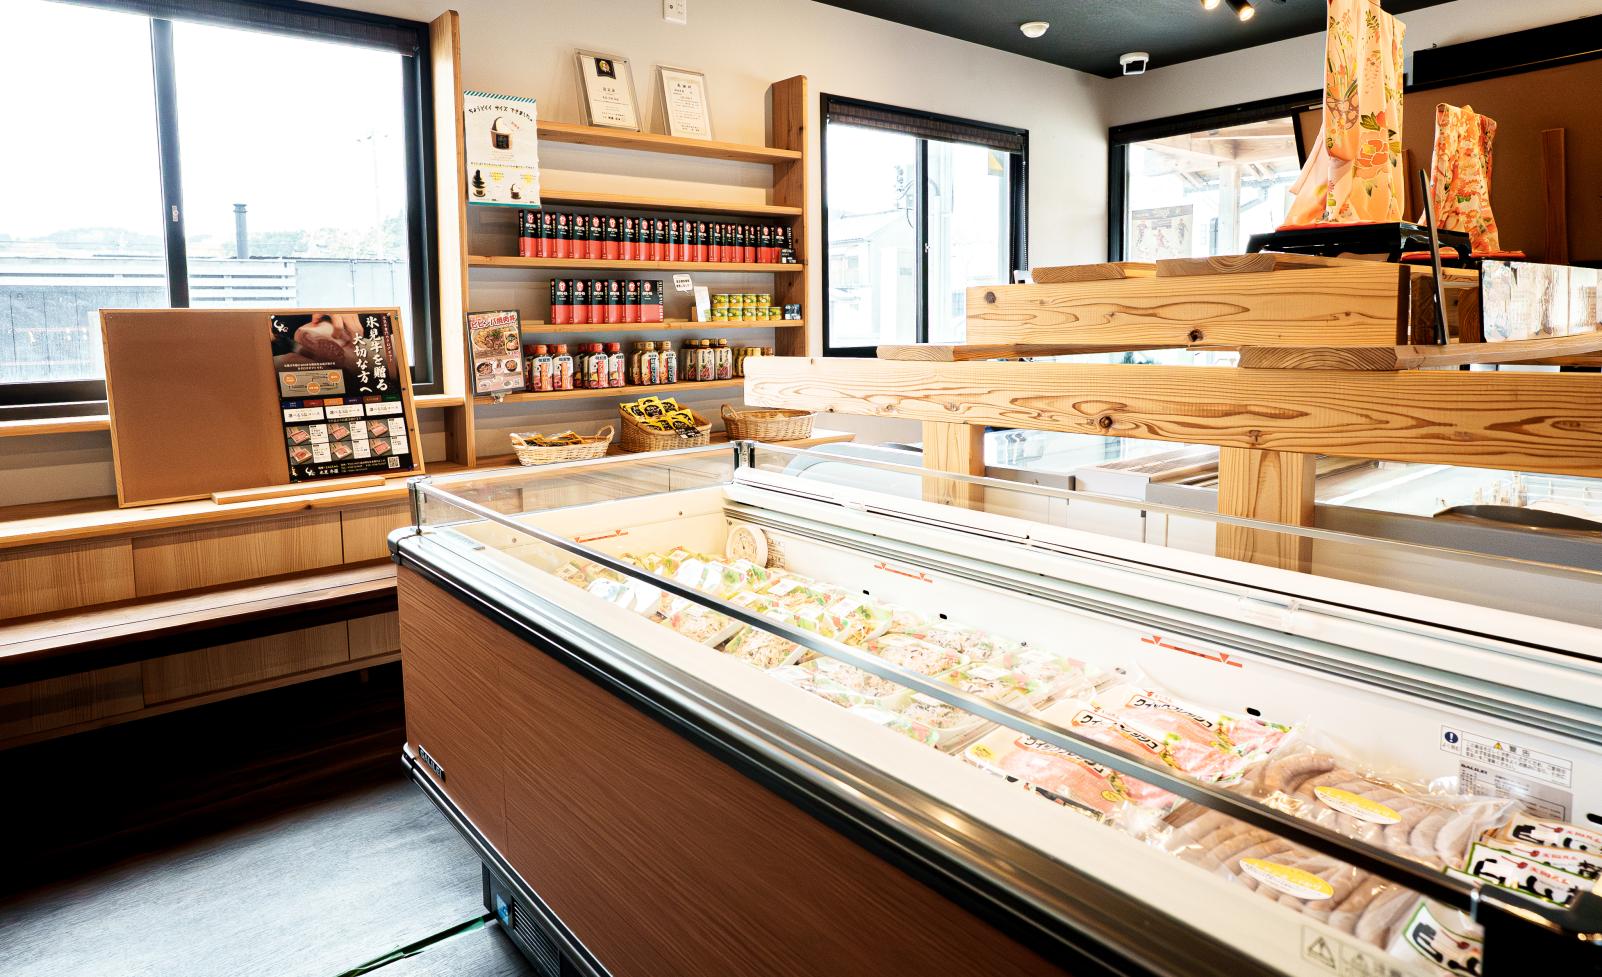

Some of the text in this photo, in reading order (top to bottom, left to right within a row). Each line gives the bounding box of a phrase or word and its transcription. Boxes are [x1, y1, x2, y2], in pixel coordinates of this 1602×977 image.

[352, 333, 373, 393] 大切な方へ
[366, 316, 388, 391] 氷見牛を贈る
